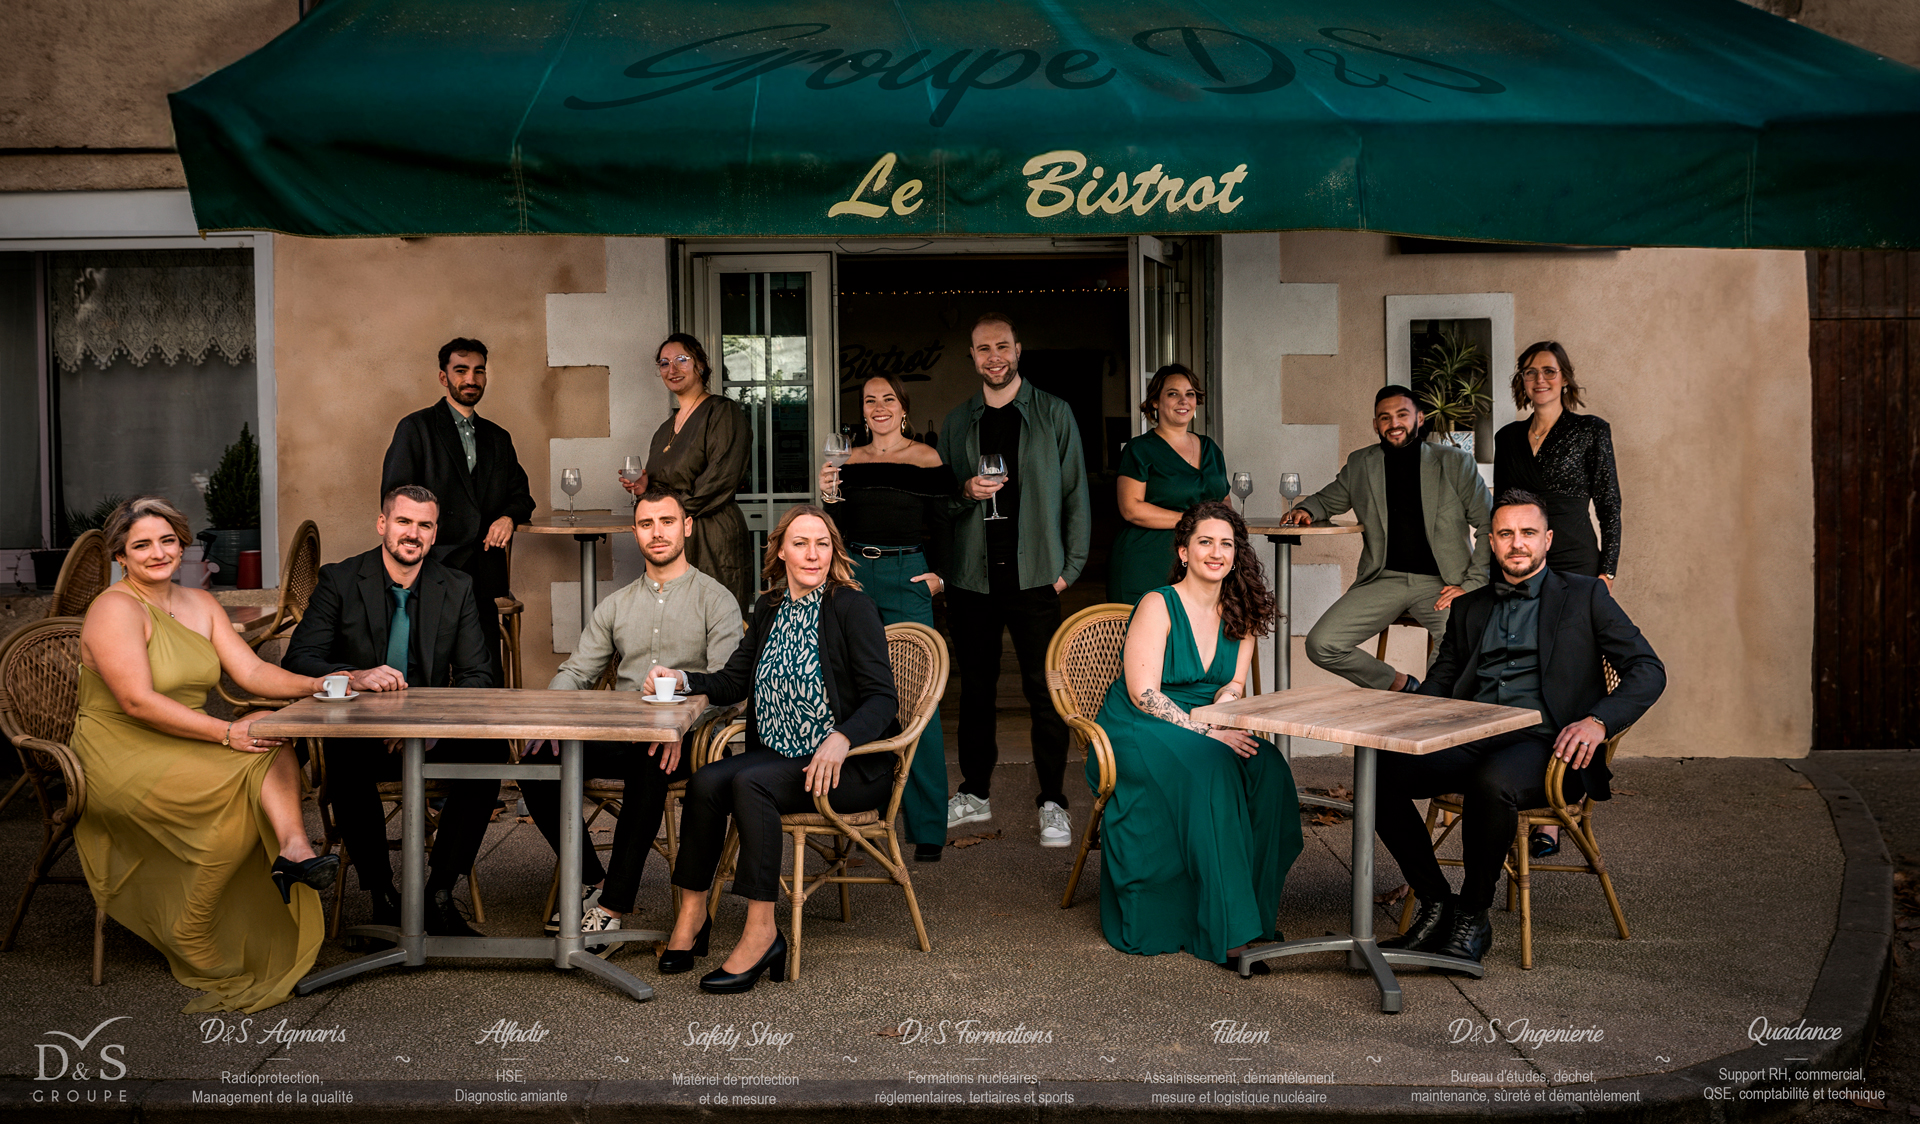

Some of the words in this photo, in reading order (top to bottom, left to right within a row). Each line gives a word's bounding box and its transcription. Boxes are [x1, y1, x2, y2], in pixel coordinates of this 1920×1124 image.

[563, 23, 1117, 127] Groupe
[1132, 27, 1506, 103] D&S
[828, 152, 924, 218] Le
[1022, 150, 1248, 218] Bistrot
[840, 339, 945, 384] Bistrot
